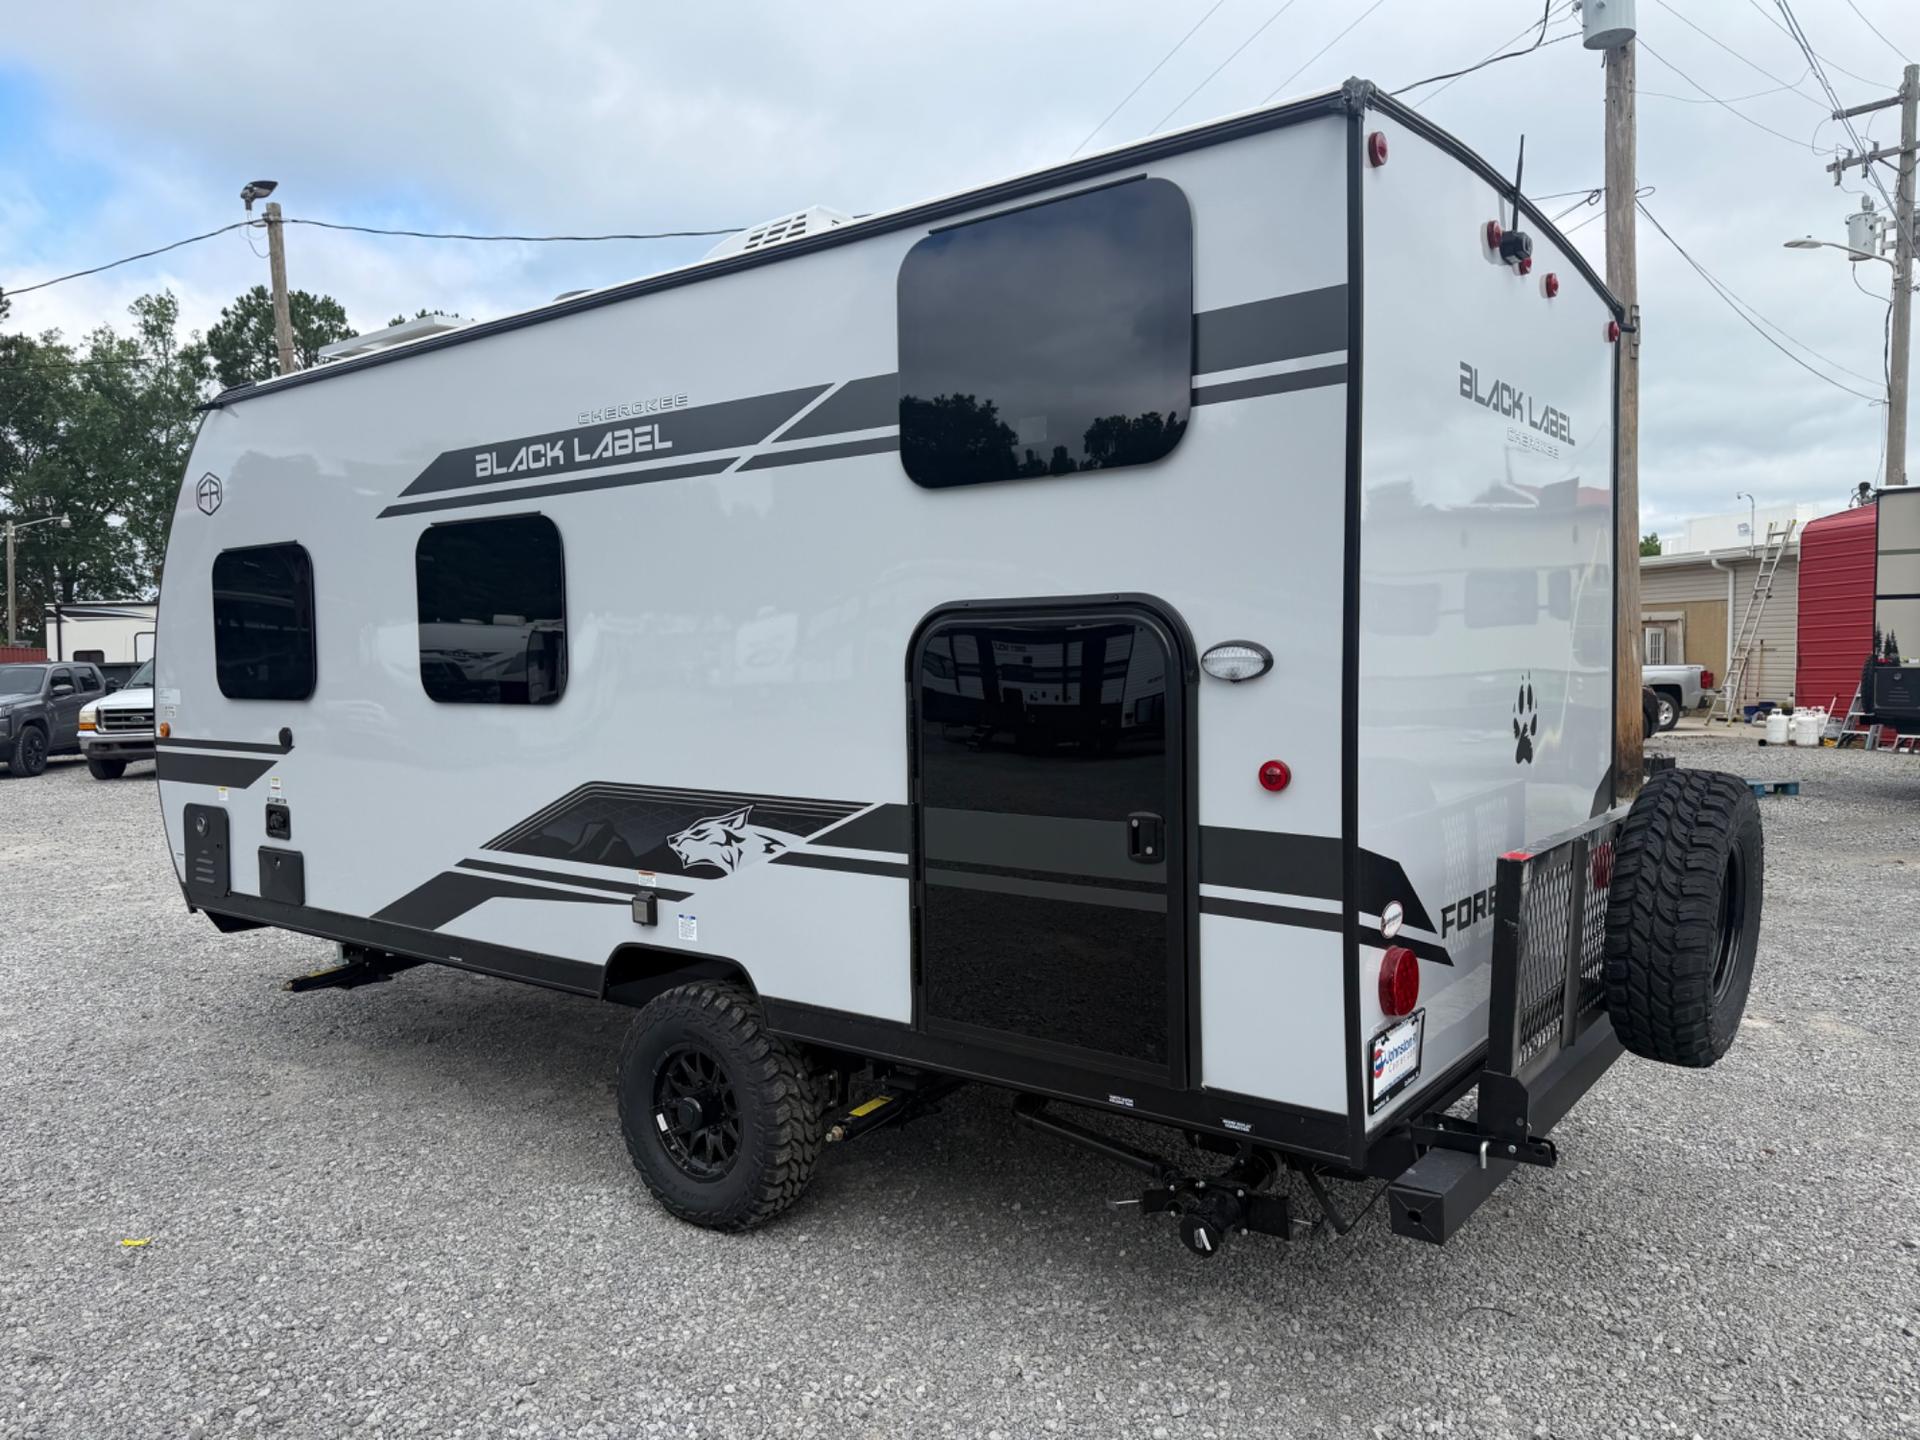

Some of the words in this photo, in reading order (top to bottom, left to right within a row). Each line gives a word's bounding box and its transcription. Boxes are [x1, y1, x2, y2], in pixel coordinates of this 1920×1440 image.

[577, 393, 688, 425] CHEROKEE
[1460, 360, 1523, 422] BLACK
[1528, 396, 1575, 446] LABEL
[475, 439, 565, 478] BLACK
[574, 423, 673, 463] LABEL
